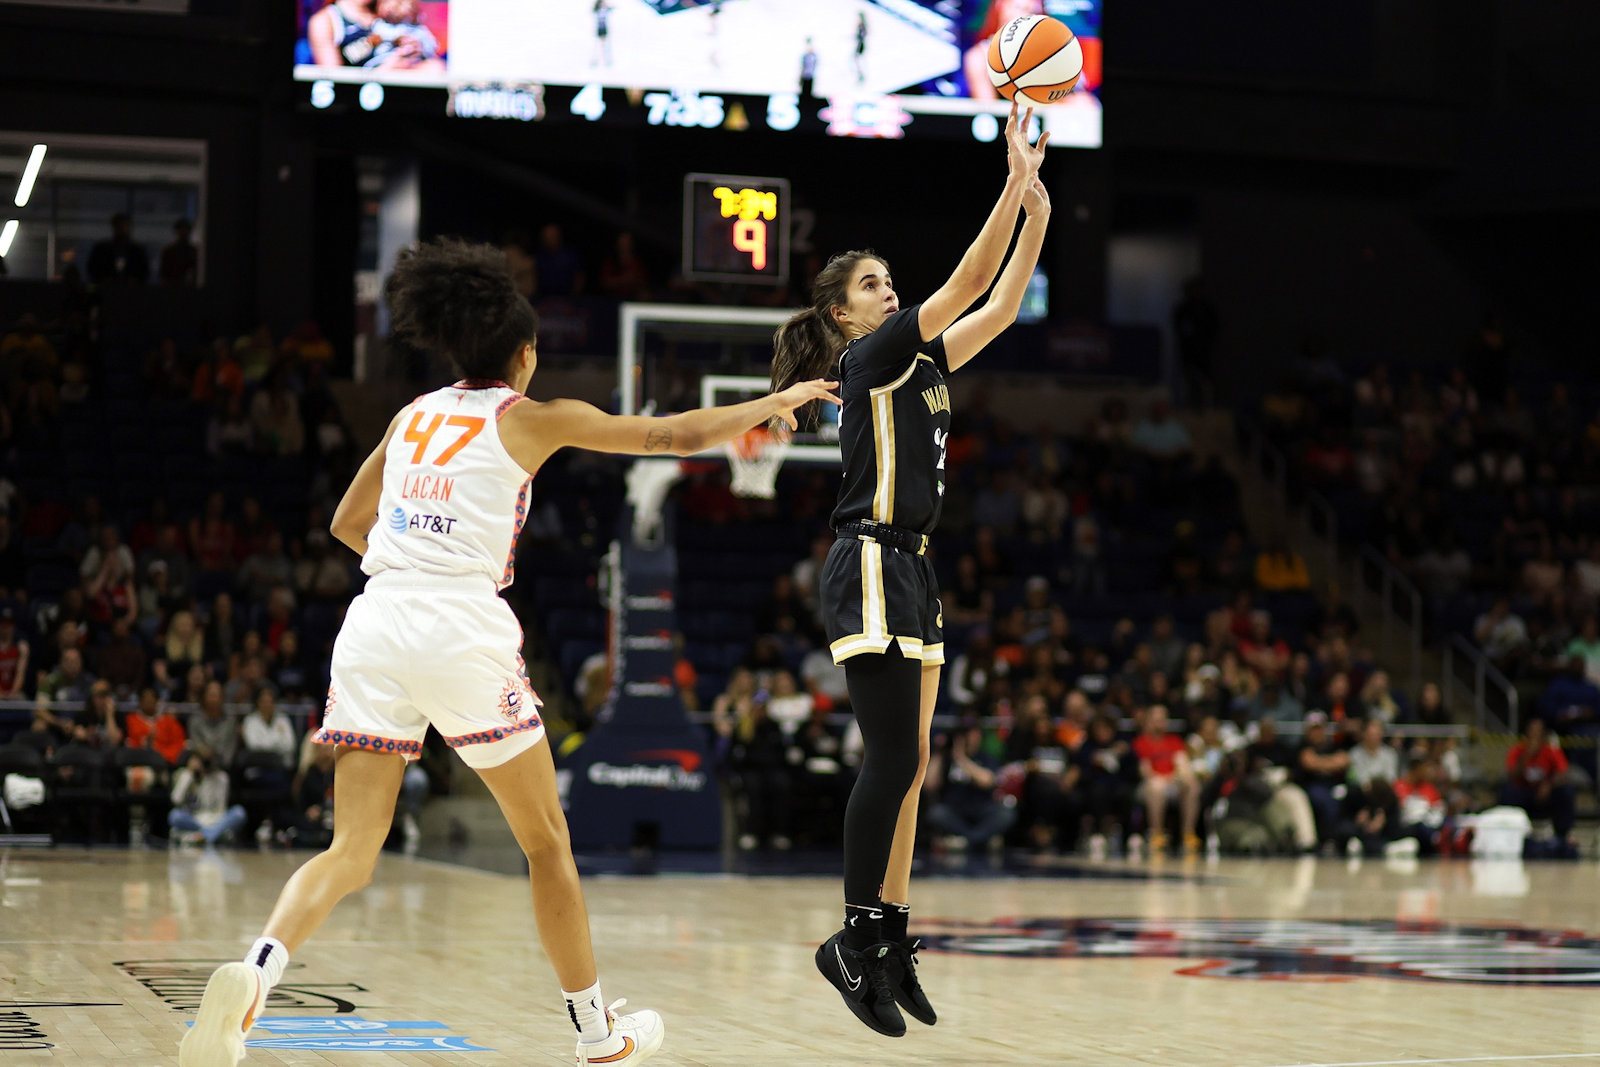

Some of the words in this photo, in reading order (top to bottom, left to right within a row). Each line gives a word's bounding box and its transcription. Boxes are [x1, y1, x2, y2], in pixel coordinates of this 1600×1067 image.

[570, 83, 606, 121] 4
[766, 93, 800, 131] 5
[733, 219, 767, 270] 9
[403, 411, 487, 467] 47
[402, 474, 455, 502] LACAN
[409, 513, 458, 535] AT&T
